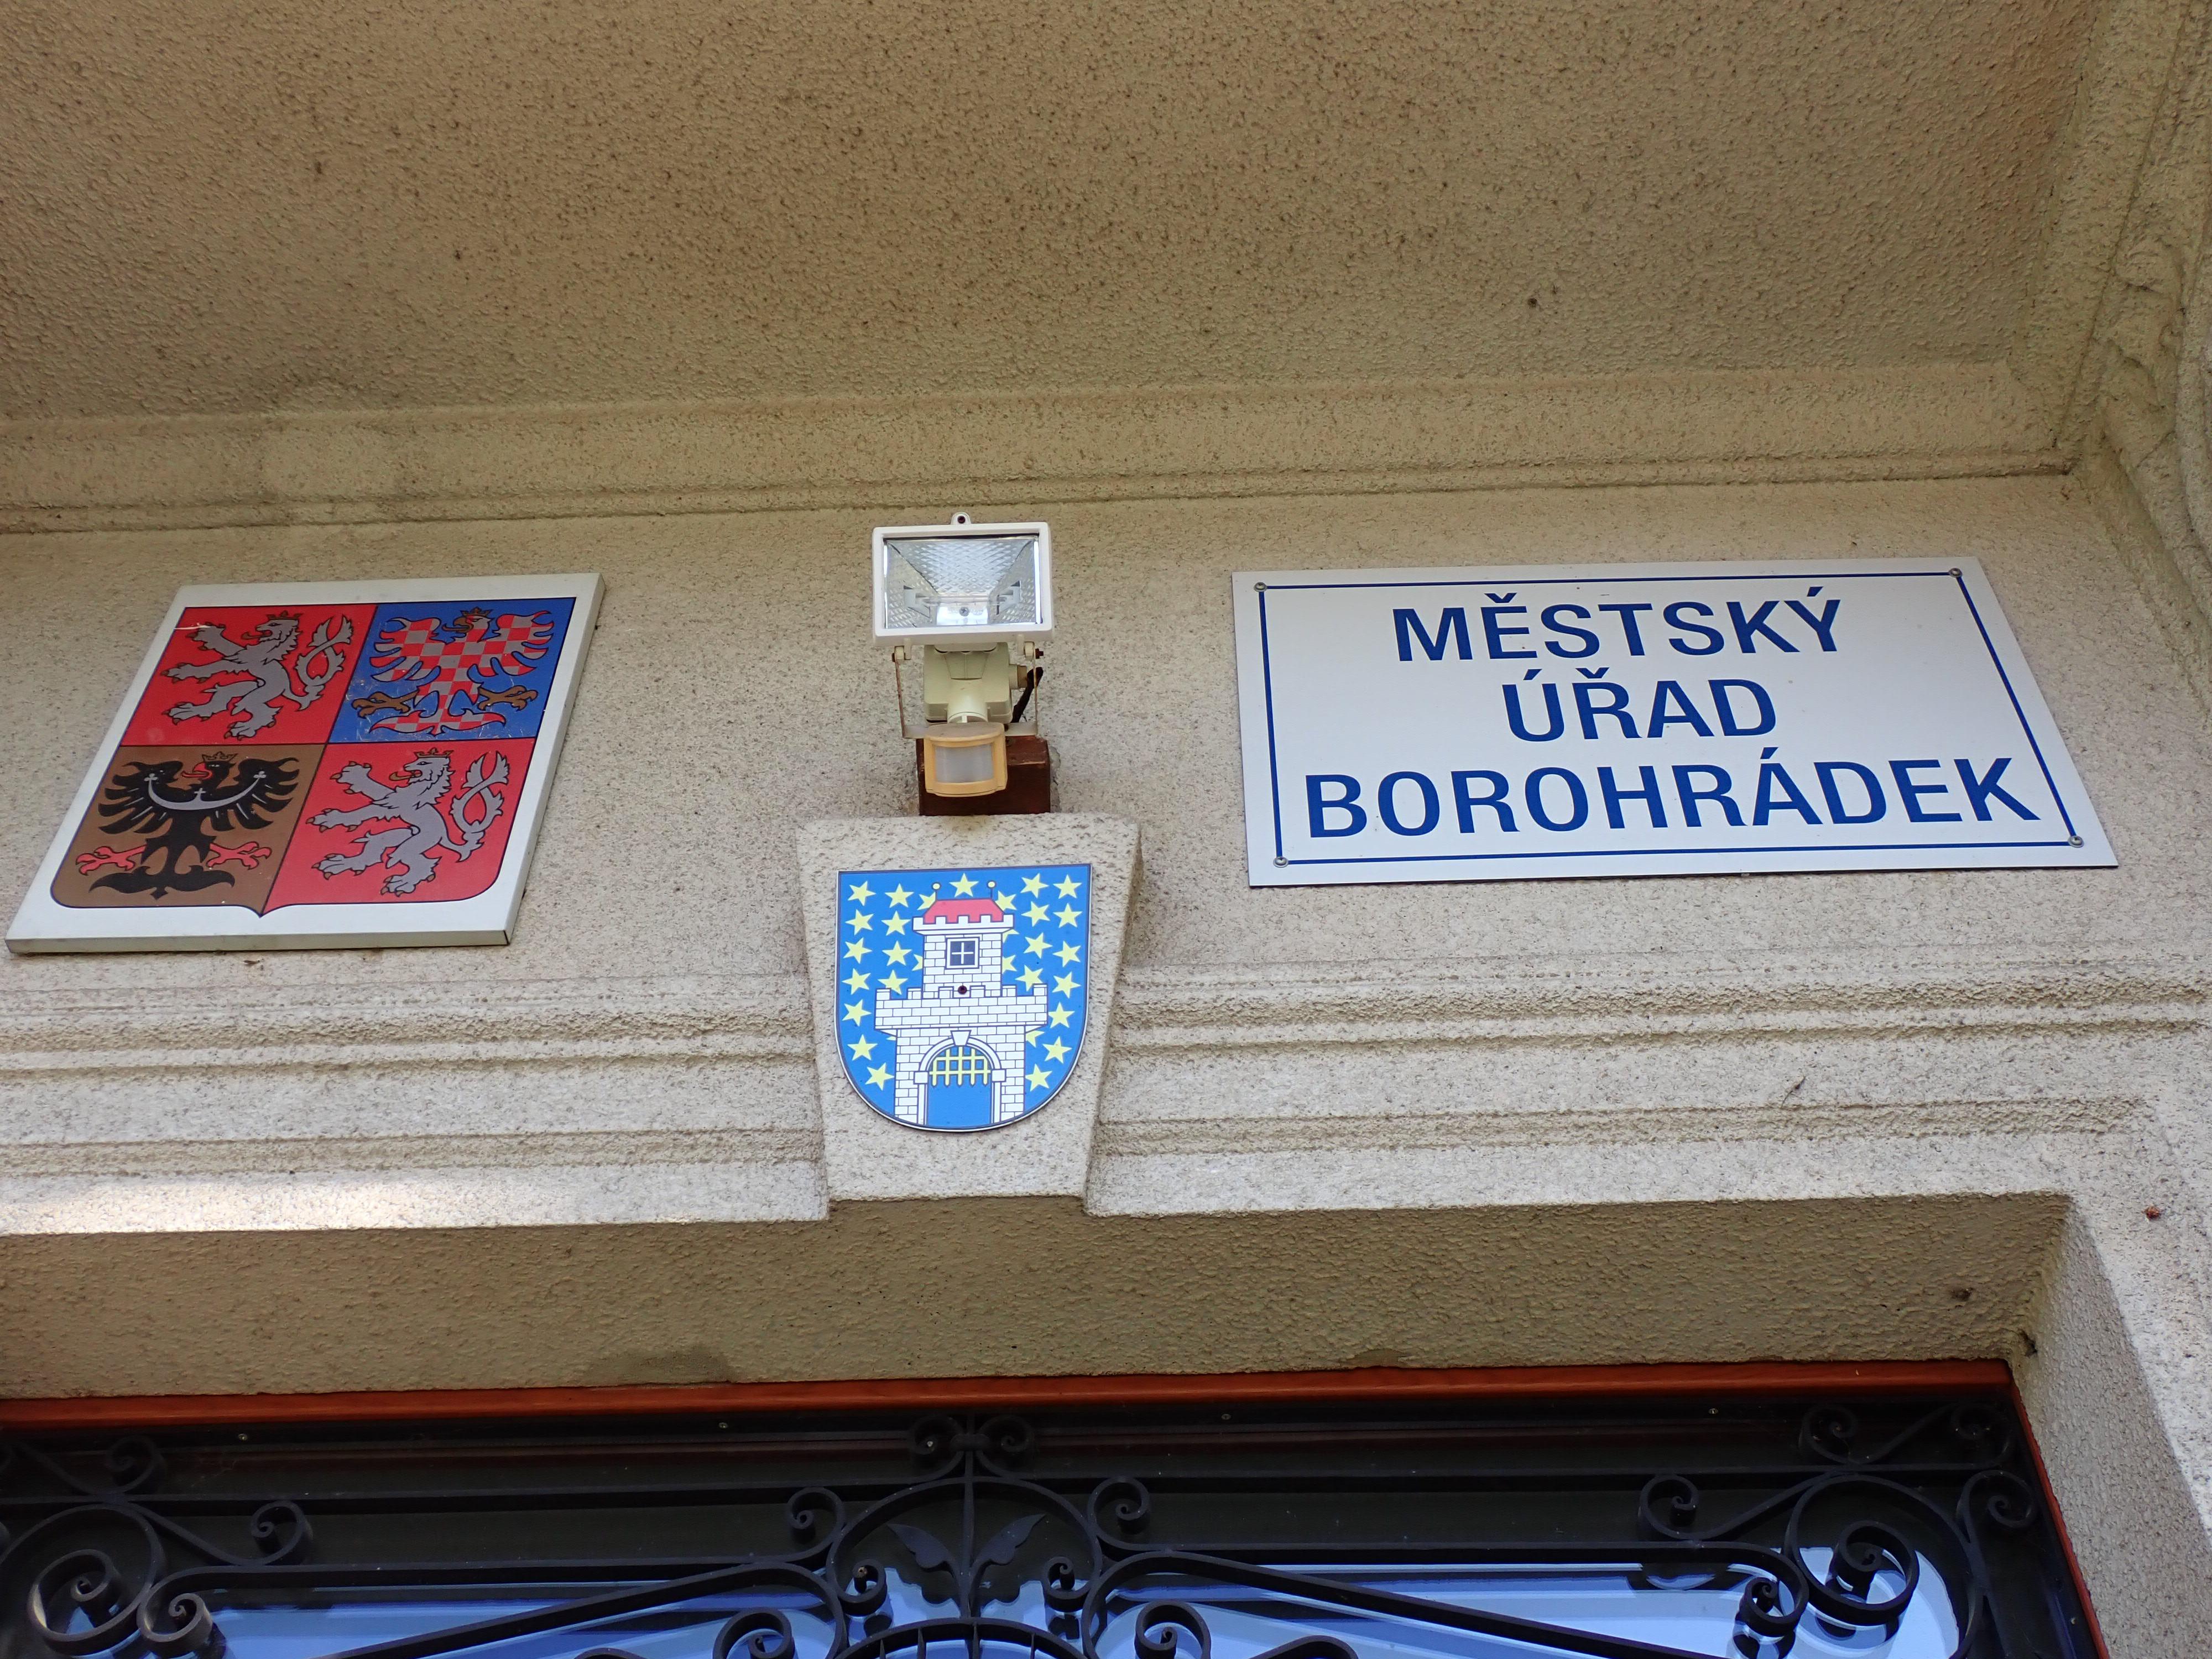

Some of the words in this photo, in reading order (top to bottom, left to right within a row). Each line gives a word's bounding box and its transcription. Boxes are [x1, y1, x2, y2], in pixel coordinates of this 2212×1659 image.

[1392, 586, 1841, 662] MĚSTSKÝ
[1502, 666, 1777, 743] ÚŘAD
[1305, 746, 2041, 838] BOROHRÁDEK
